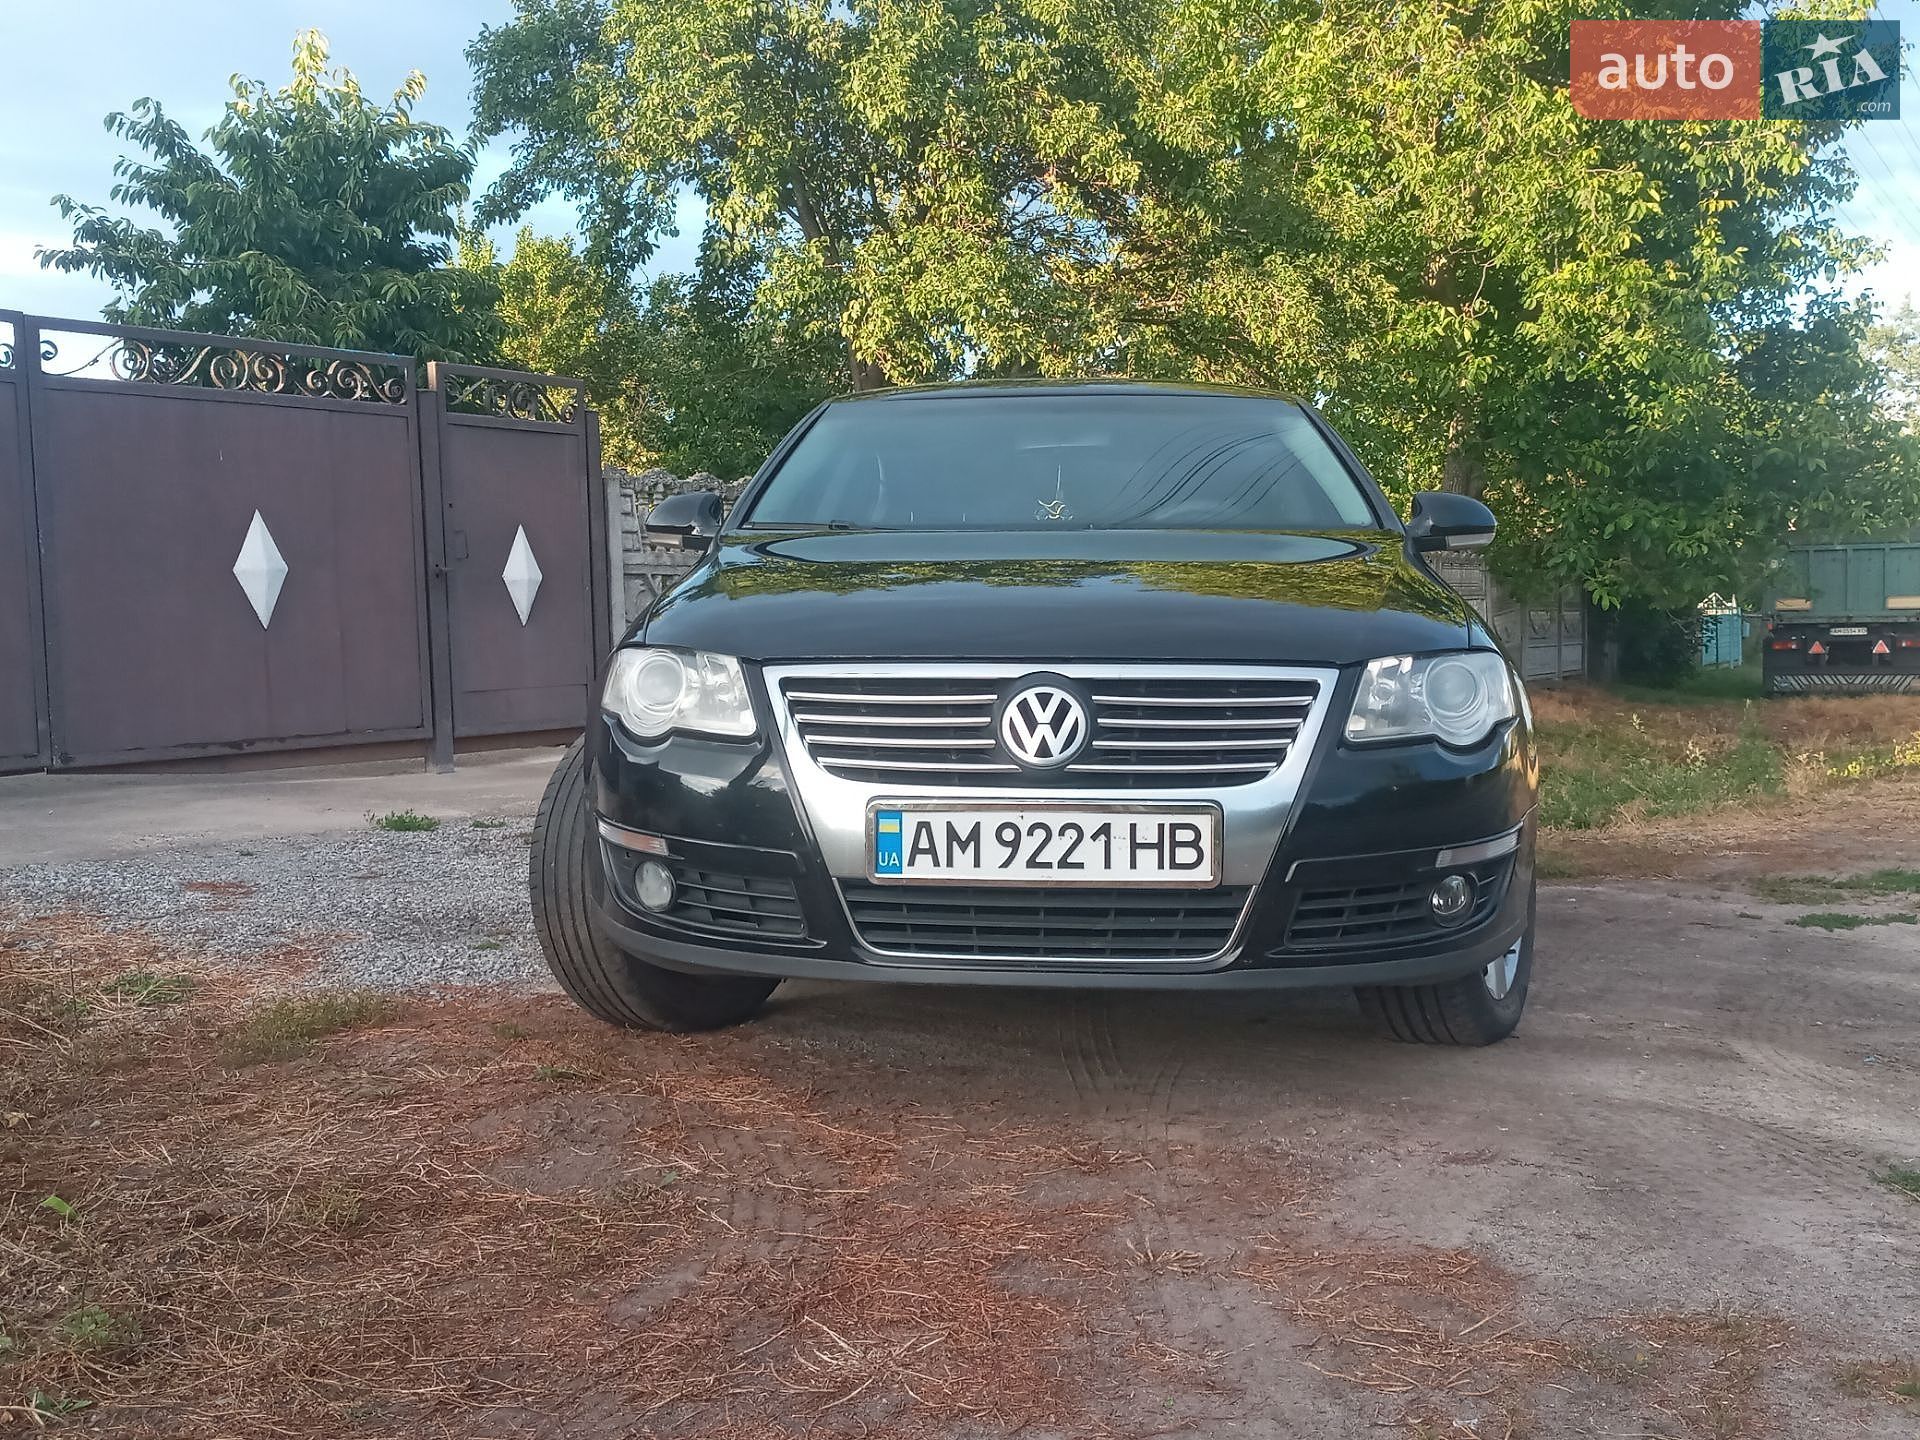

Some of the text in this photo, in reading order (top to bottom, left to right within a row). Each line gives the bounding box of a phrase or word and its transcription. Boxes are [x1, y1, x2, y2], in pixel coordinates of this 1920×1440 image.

[1002, 686, 1086, 767] VW
[878, 851, 900, 867] UA
[907, 821, 1205, 870] AM 9221 HB
